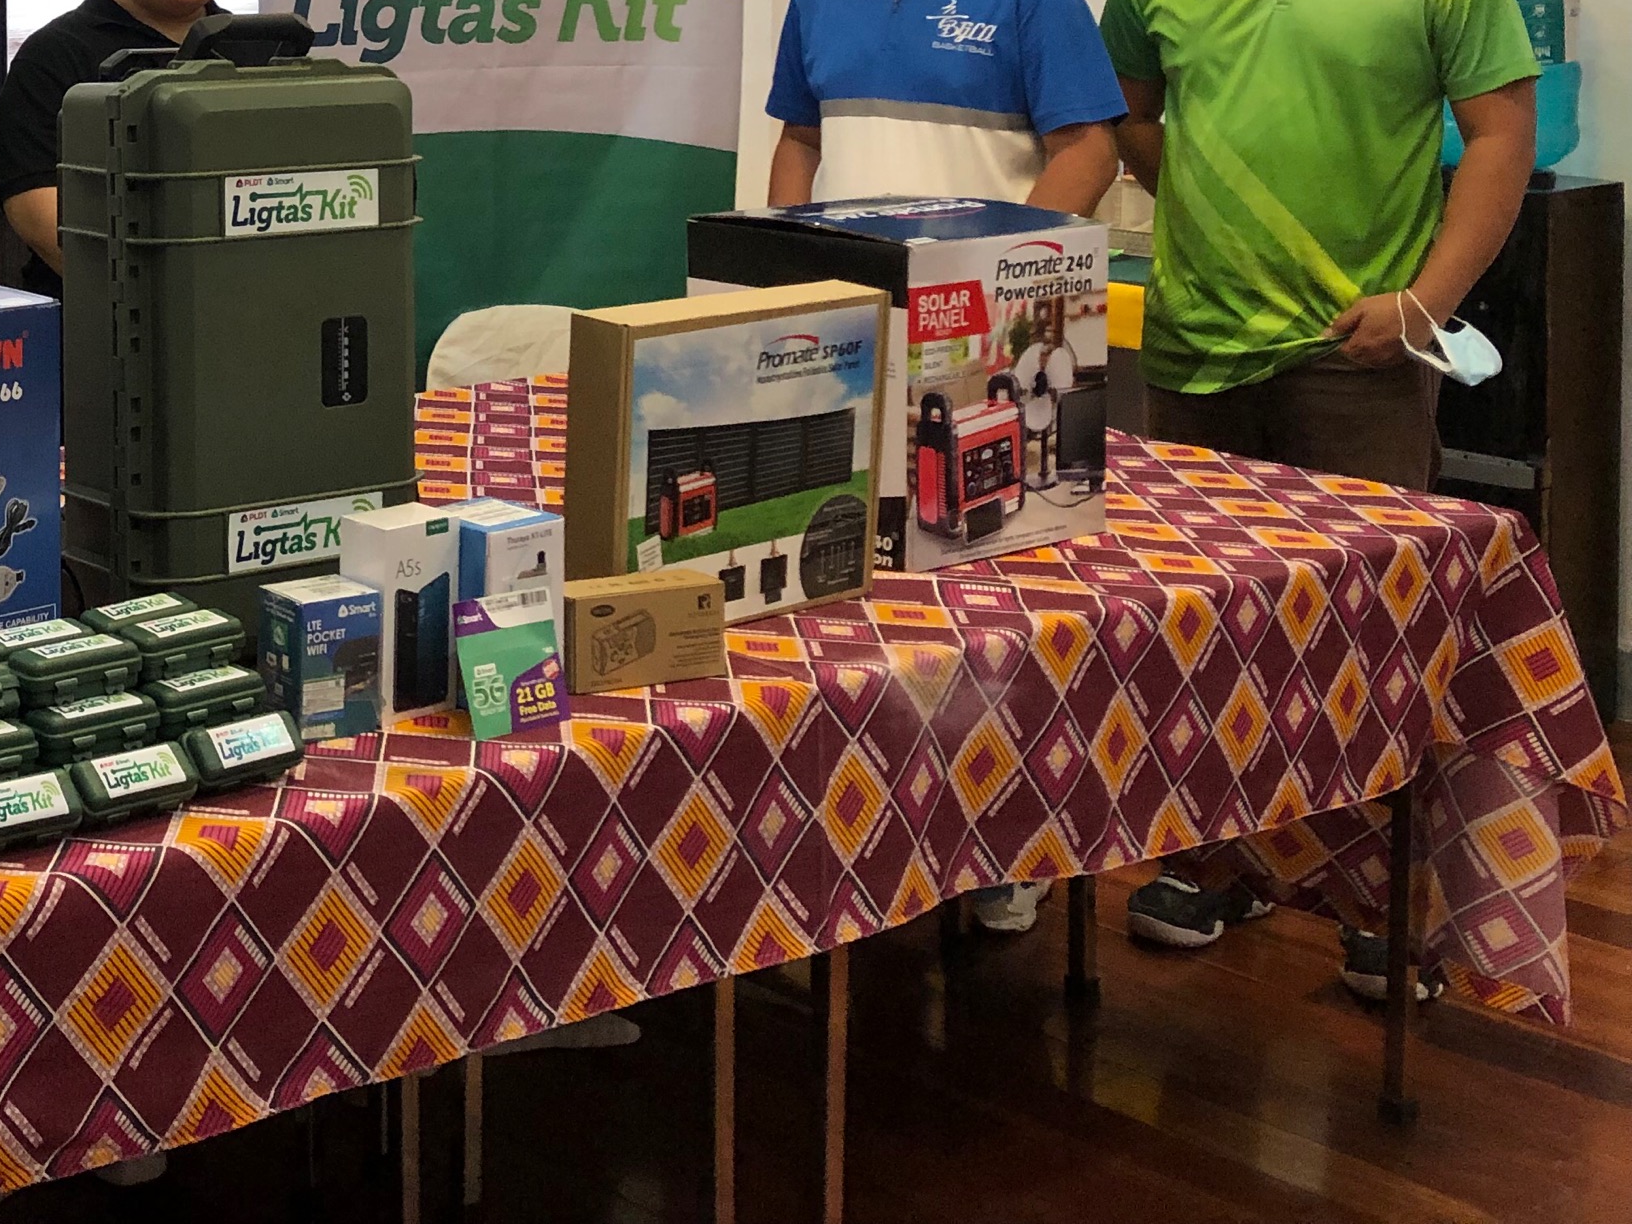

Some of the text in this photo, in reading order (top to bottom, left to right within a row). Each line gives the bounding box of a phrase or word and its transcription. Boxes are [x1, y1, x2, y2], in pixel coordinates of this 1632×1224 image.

[244, 178, 263, 187] PLDT
[231, 188, 357, 232] Ligtas Kit
[995, 253, 1094, 281] Promate 240
[994, 276, 1093, 303] Powerstation
[917, 289, 971, 313] SOLAR
[917, 307, 970, 332] PANEL
[756, 339, 863, 370] Promate SP60F
[249, 511, 268, 522] PLDT
[235, 530, 317, 565] Ligtas
[395, 558, 422, 579] A5s
[348, 601, 377, 616] Smart
[5, 612, 50, 629] CAPABILITY
[306, 619, 322, 633] LTE
[306, 628, 346, 645] POCKET
[306, 644, 328, 657] WIFI
[472, 674, 507, 709] 5G
[516, 687, 534, 704] 21
[535, 681, 556, 699] GB
[217, 738, 261, 761] Ligtas
[102, 769, 150, 790] Ligtas
[29, 790, 54, 812] Kit
